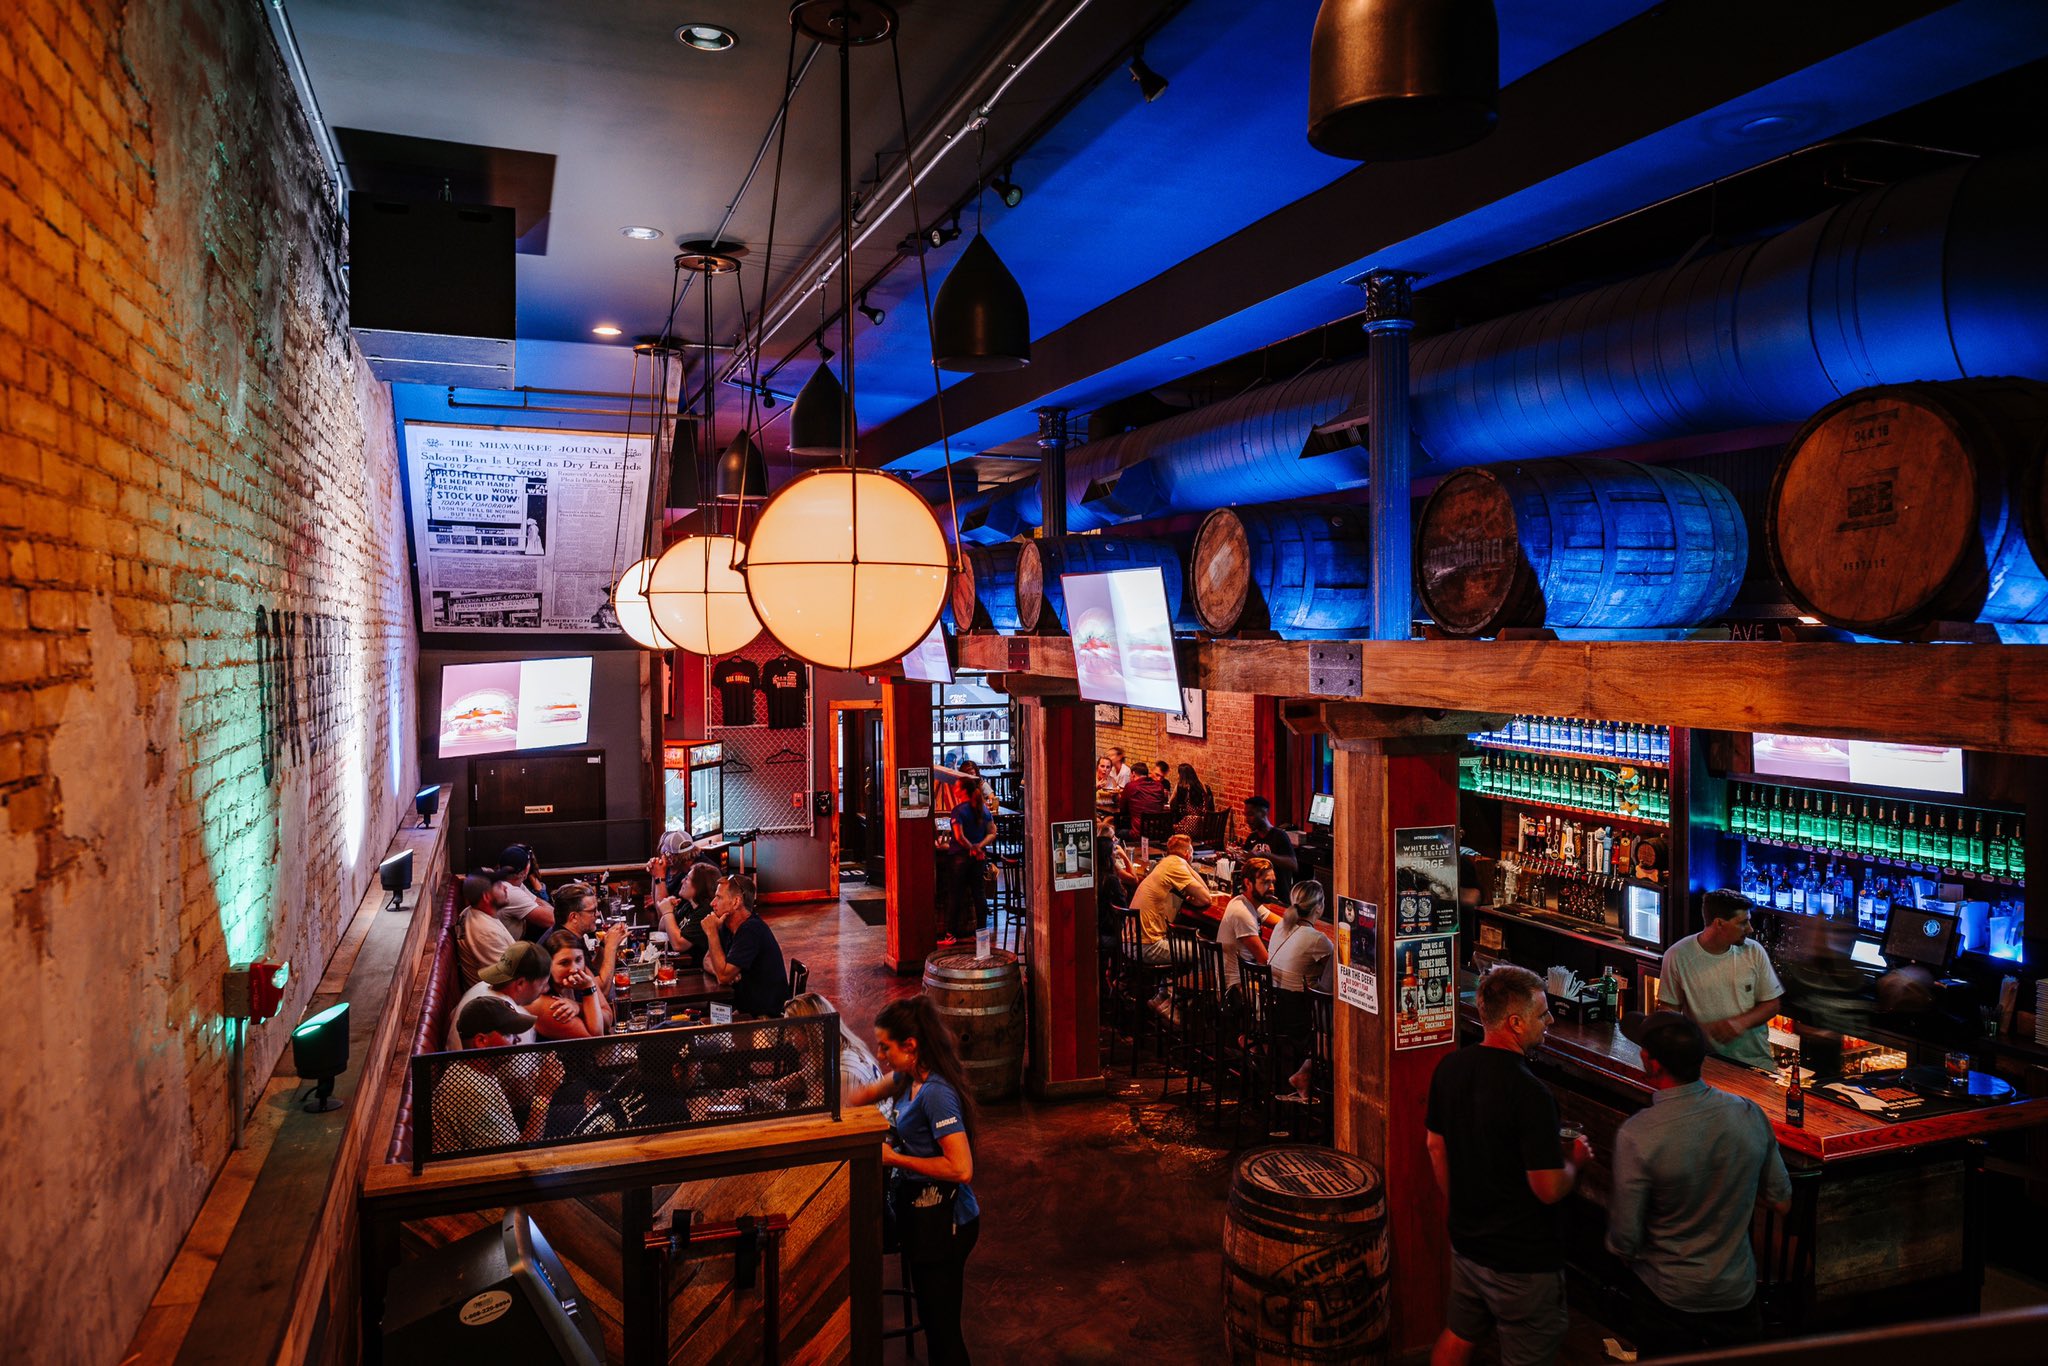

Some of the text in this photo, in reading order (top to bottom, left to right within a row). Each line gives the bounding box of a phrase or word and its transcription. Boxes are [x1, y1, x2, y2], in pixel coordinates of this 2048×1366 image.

[480, 441, 552, 452] MILWAUKEE
[559, 446, 615, 455] JOURNAL
[421, 452, 459, 462] Saloon
[464, 454, 487, 464] Ban
[492, 456, 502, 464] Is
[506, 457, 542, 468] Urged
[563, 460, 585, 470] Dry
[589, 461, 609, 470] Era
[614, 462, 642, 470] Ends
[435, 469, 516, 482] PROHIBITION
[450, 478, 473, 486] NEAR
[434, 484, 467, 492] PREPARE
[437, 491, 473, 501] STOCK
[475, 493, 489, 502] UP
[1403, 843, 1449, 852] WHITE CLAW
[1423, 849, 1449, 857] SELTZER
[1411, 859, 1445, 870] SURGE
[1340, 965, 1351, 977] FEAR
[1351, 969, 1361, 981] THE
